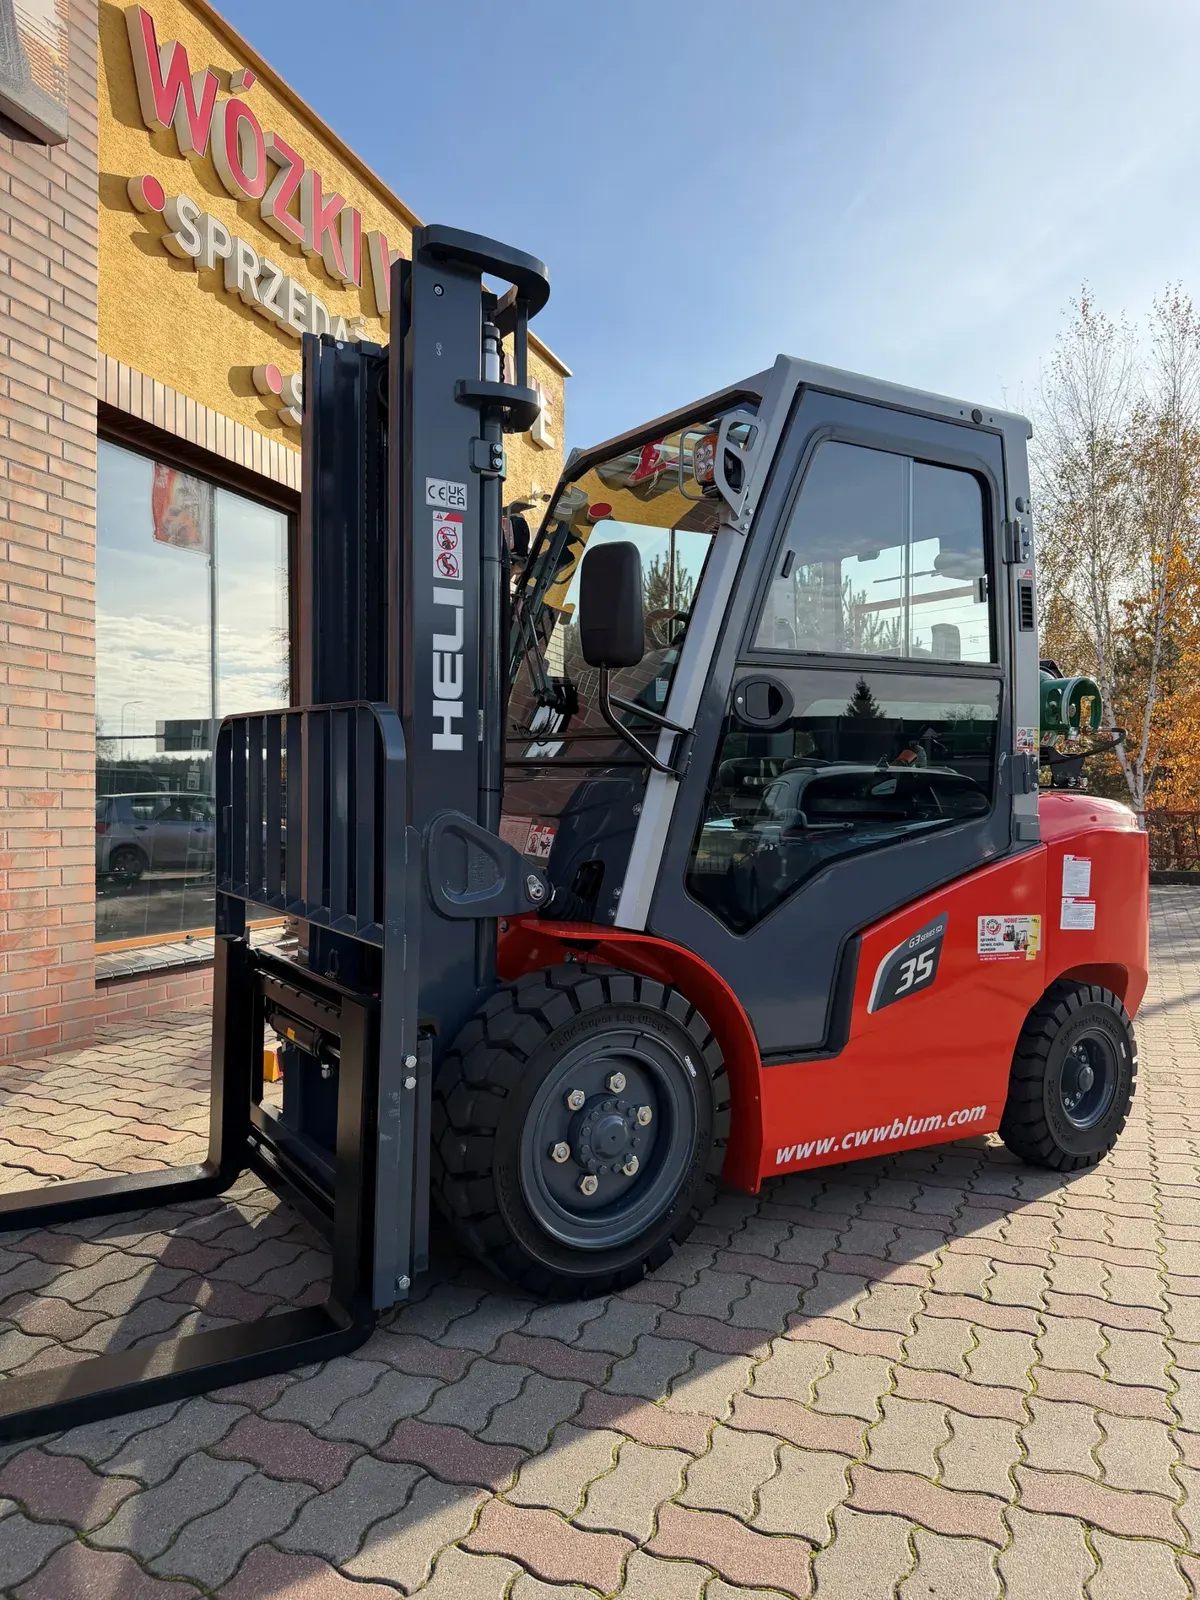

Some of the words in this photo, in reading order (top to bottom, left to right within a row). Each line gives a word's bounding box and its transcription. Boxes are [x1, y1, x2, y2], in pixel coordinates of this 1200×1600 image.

[125, 4, 363, 291] WÓZKI
[448, 485, 465, 497] UK
[448, 495, 465, 507] CA
[432, 586, 464, 751] HELI
[908, 934, 921, 949] G3
[894, 946, 936, 996] 35
[775, 1103, 988, 1165] www.cwwblum.com
